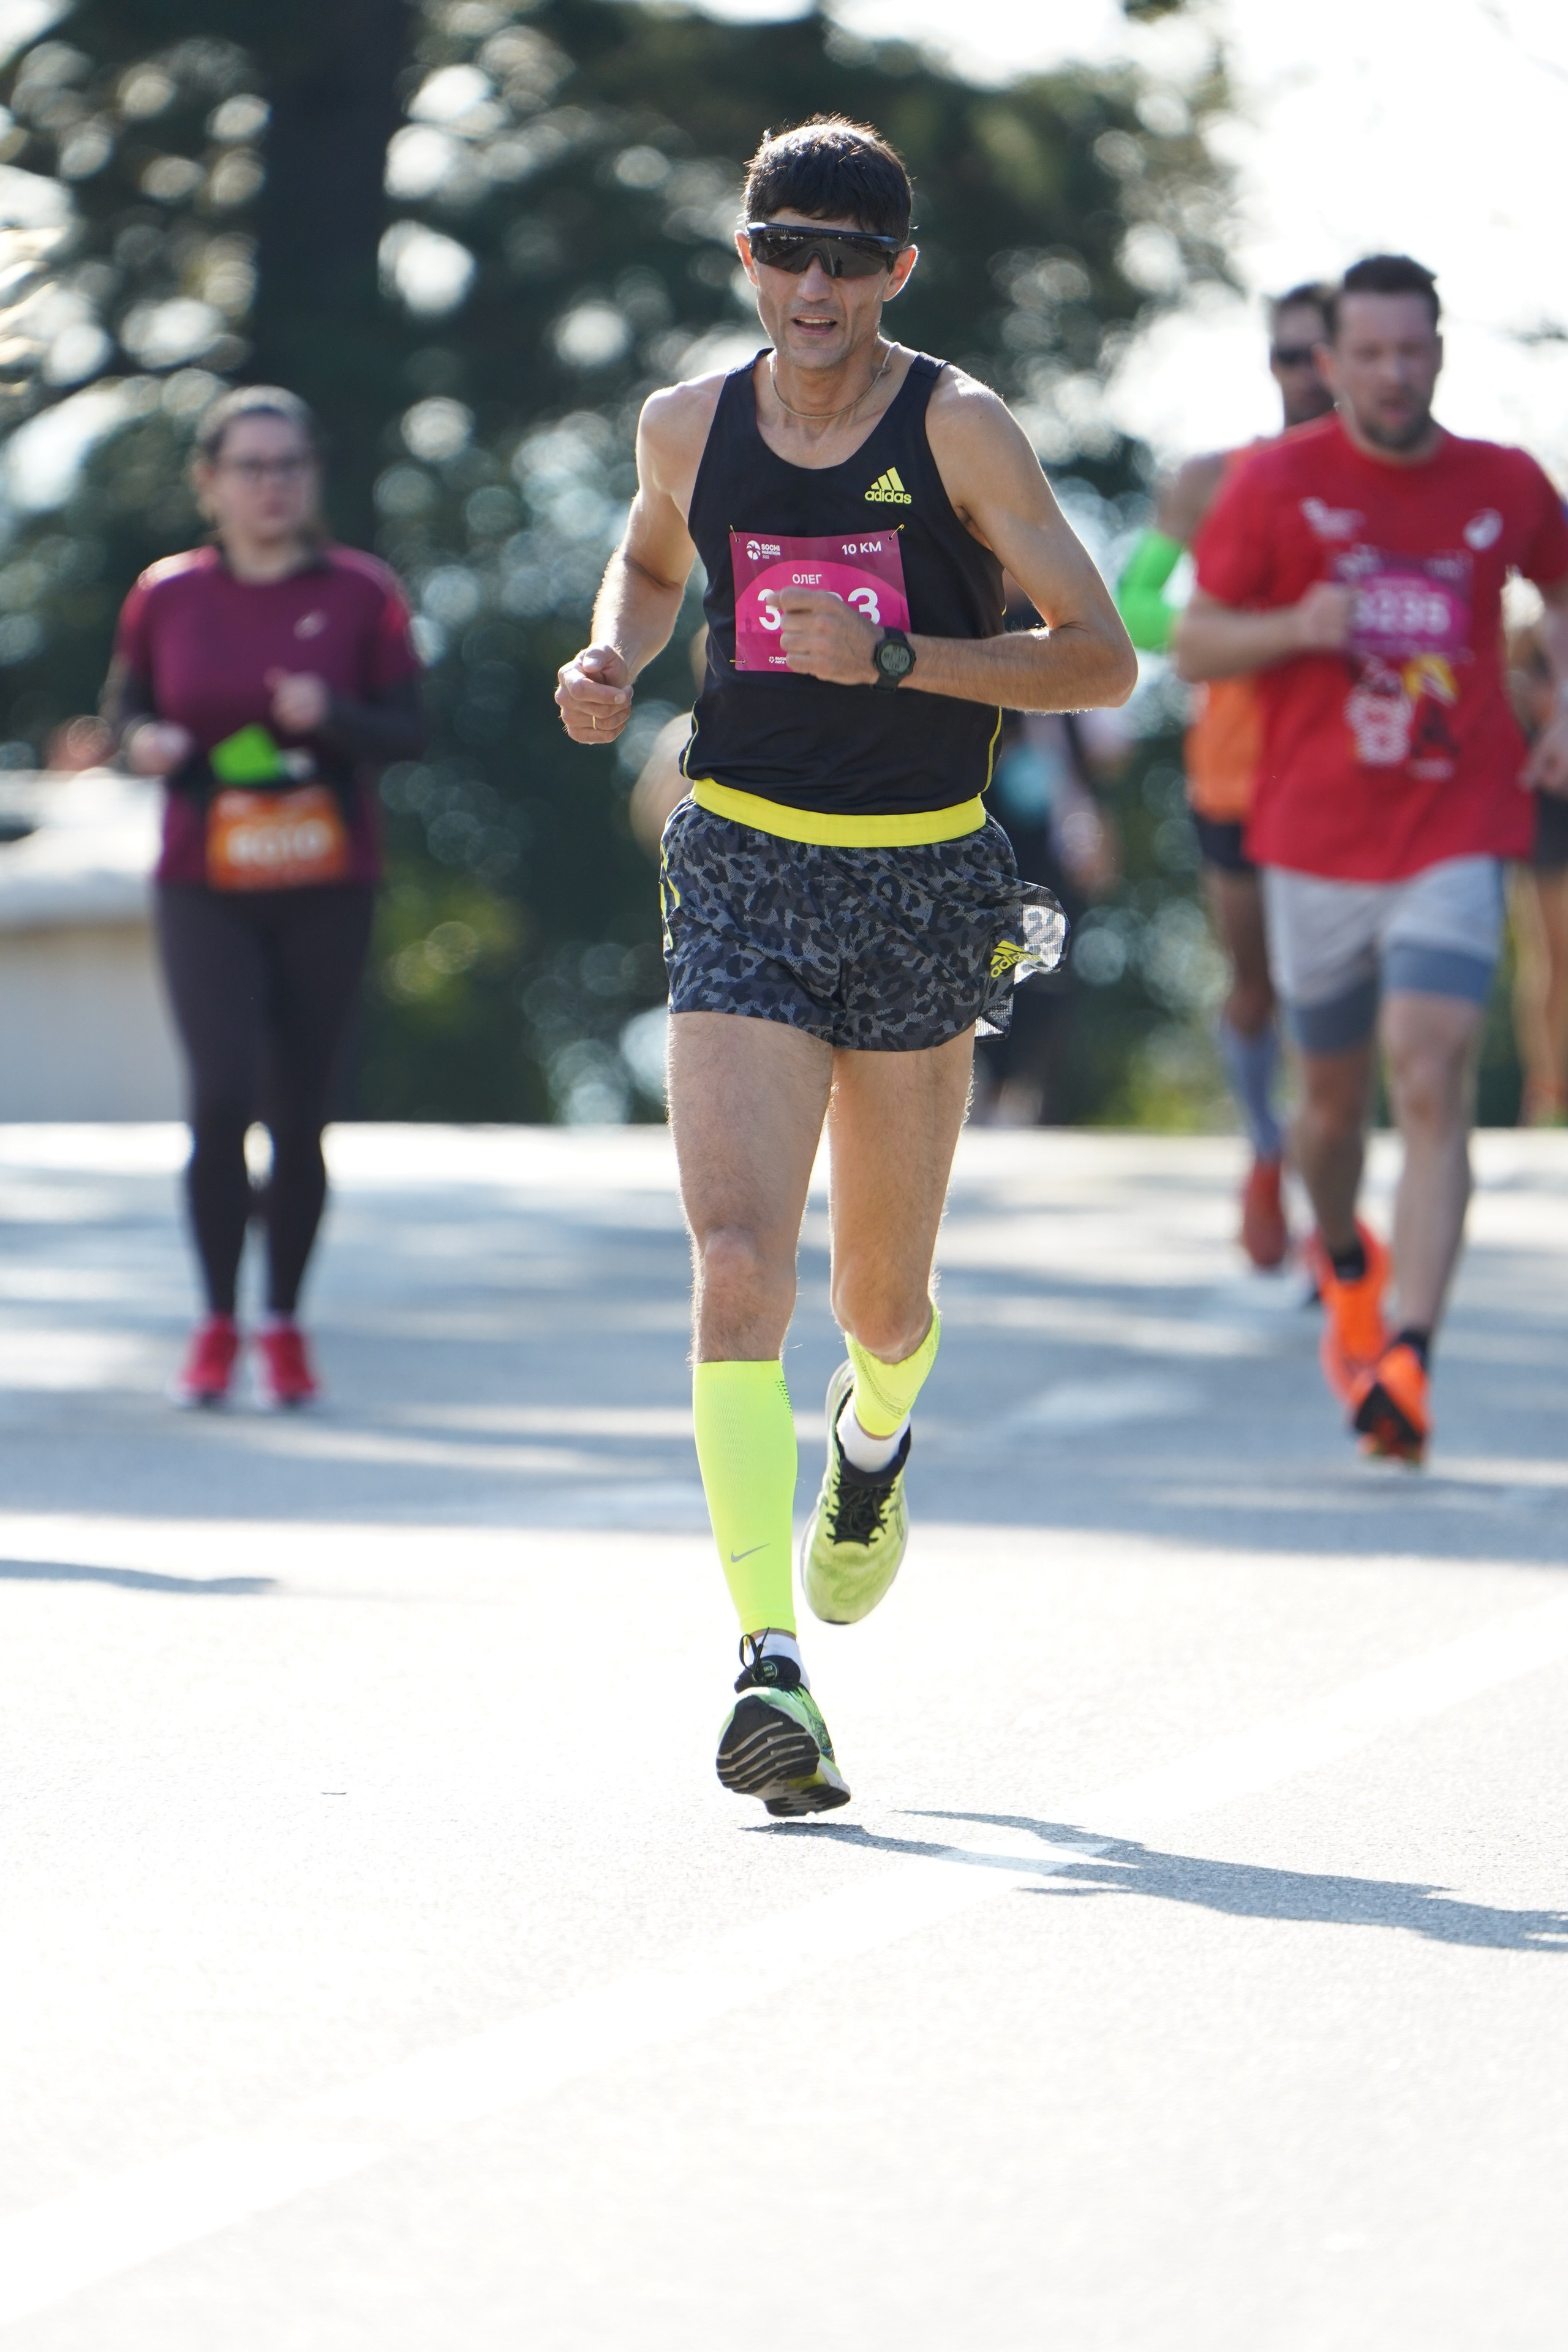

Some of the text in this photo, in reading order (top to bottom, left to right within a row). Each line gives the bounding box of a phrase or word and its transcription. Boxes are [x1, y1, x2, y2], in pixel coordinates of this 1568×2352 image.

[864, 488, 912, 505] adidas
[842, 541, 882, 555] 10 KM
[792, 573, 822, 584] ОЛЕГ
[757, 587, 880, 631] 33
